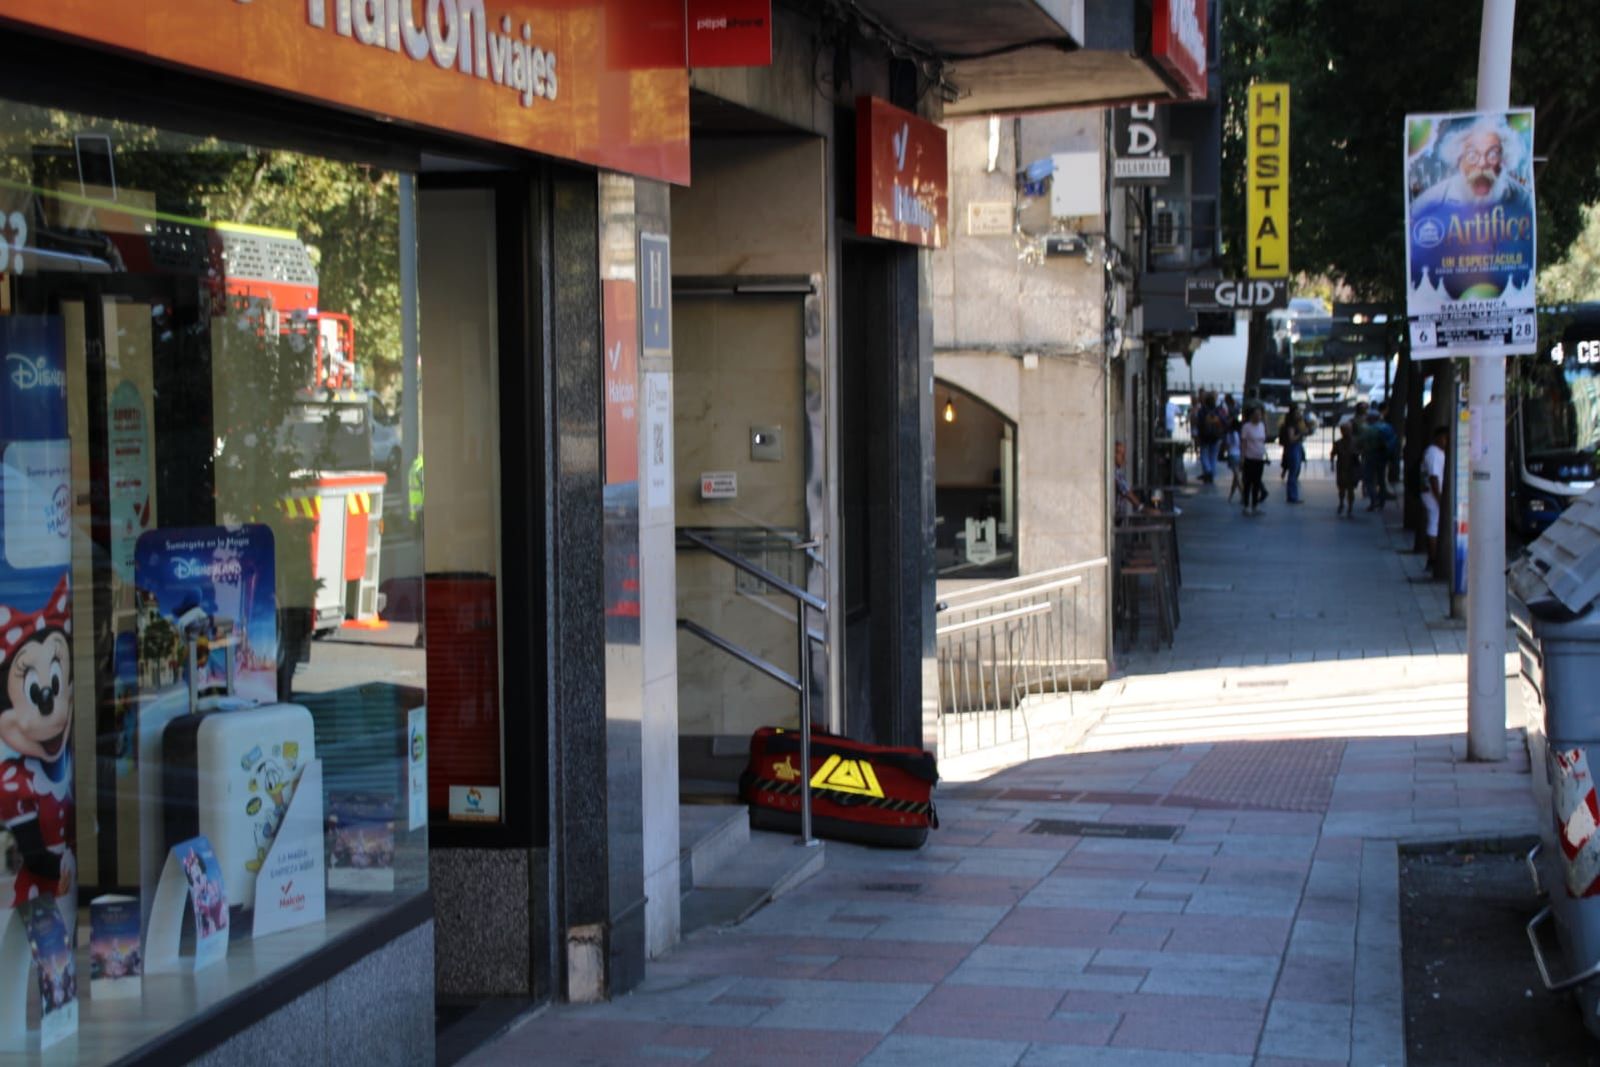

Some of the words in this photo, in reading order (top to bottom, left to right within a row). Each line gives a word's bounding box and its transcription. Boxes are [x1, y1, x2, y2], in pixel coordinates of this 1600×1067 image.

[487, 14, 557, 108] viajes
[1256, 91, 1281, 270] HOSTAL
[1440, 301, 1508, 312] SALAMANCA
[1418, 330, 1428, 343] 6
[1515, 323, 1532, 337] 28
